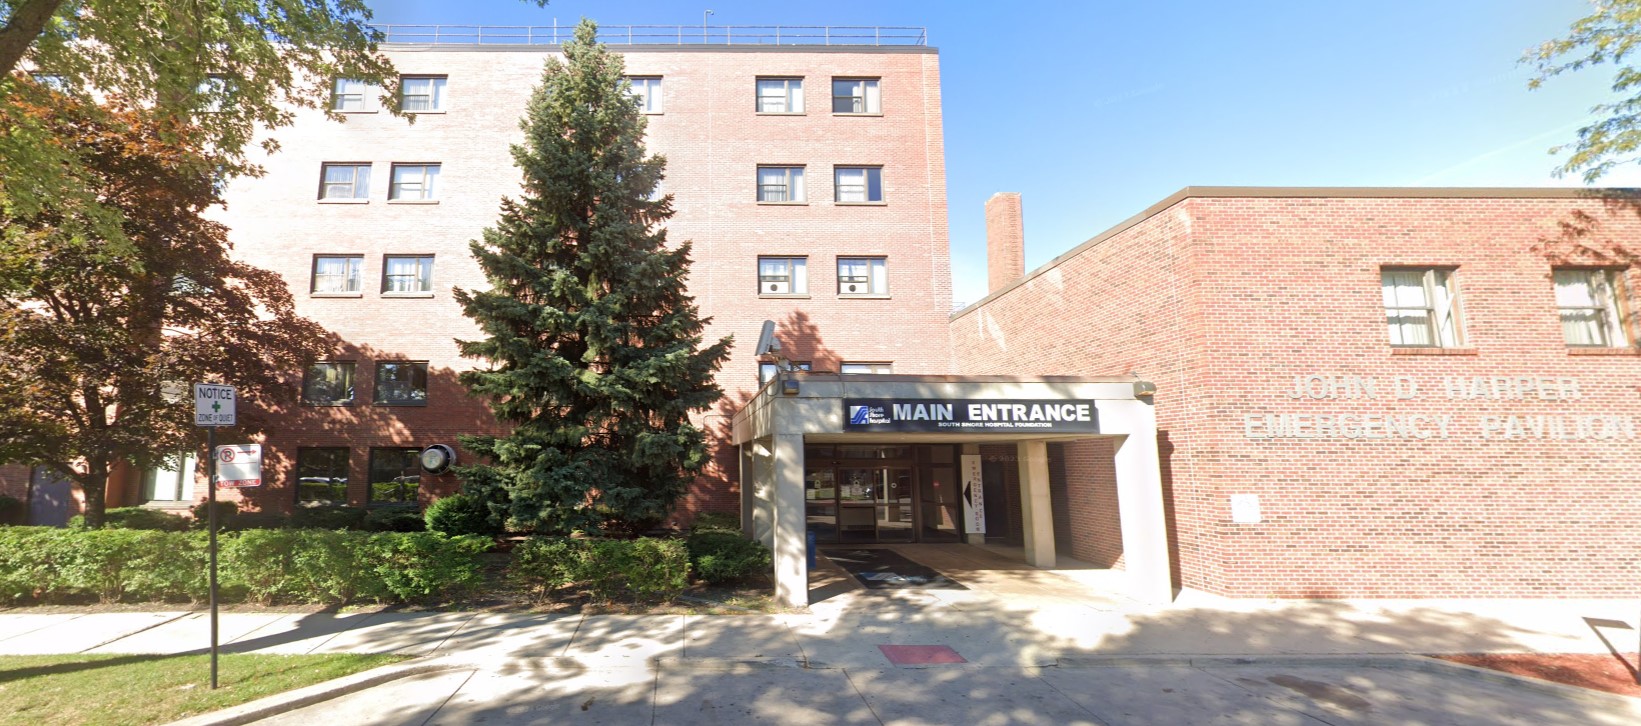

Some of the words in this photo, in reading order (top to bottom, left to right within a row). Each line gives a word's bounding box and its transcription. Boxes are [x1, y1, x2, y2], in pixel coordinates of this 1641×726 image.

[198, 387, 232, 400] NOTICE
[1287, 375, 1378, 400] JOHN
[1446, 376, 1582, 400] HARPER
[198, 413, 213, 422] ZONE
[893, 404, 953, 421] MAIN
[968, 404, 1091, 422] ENTRANCE
[1244, 412, 1454, 440] EMERGENCY
[1482, 414, 1637, 441] PAVILION
